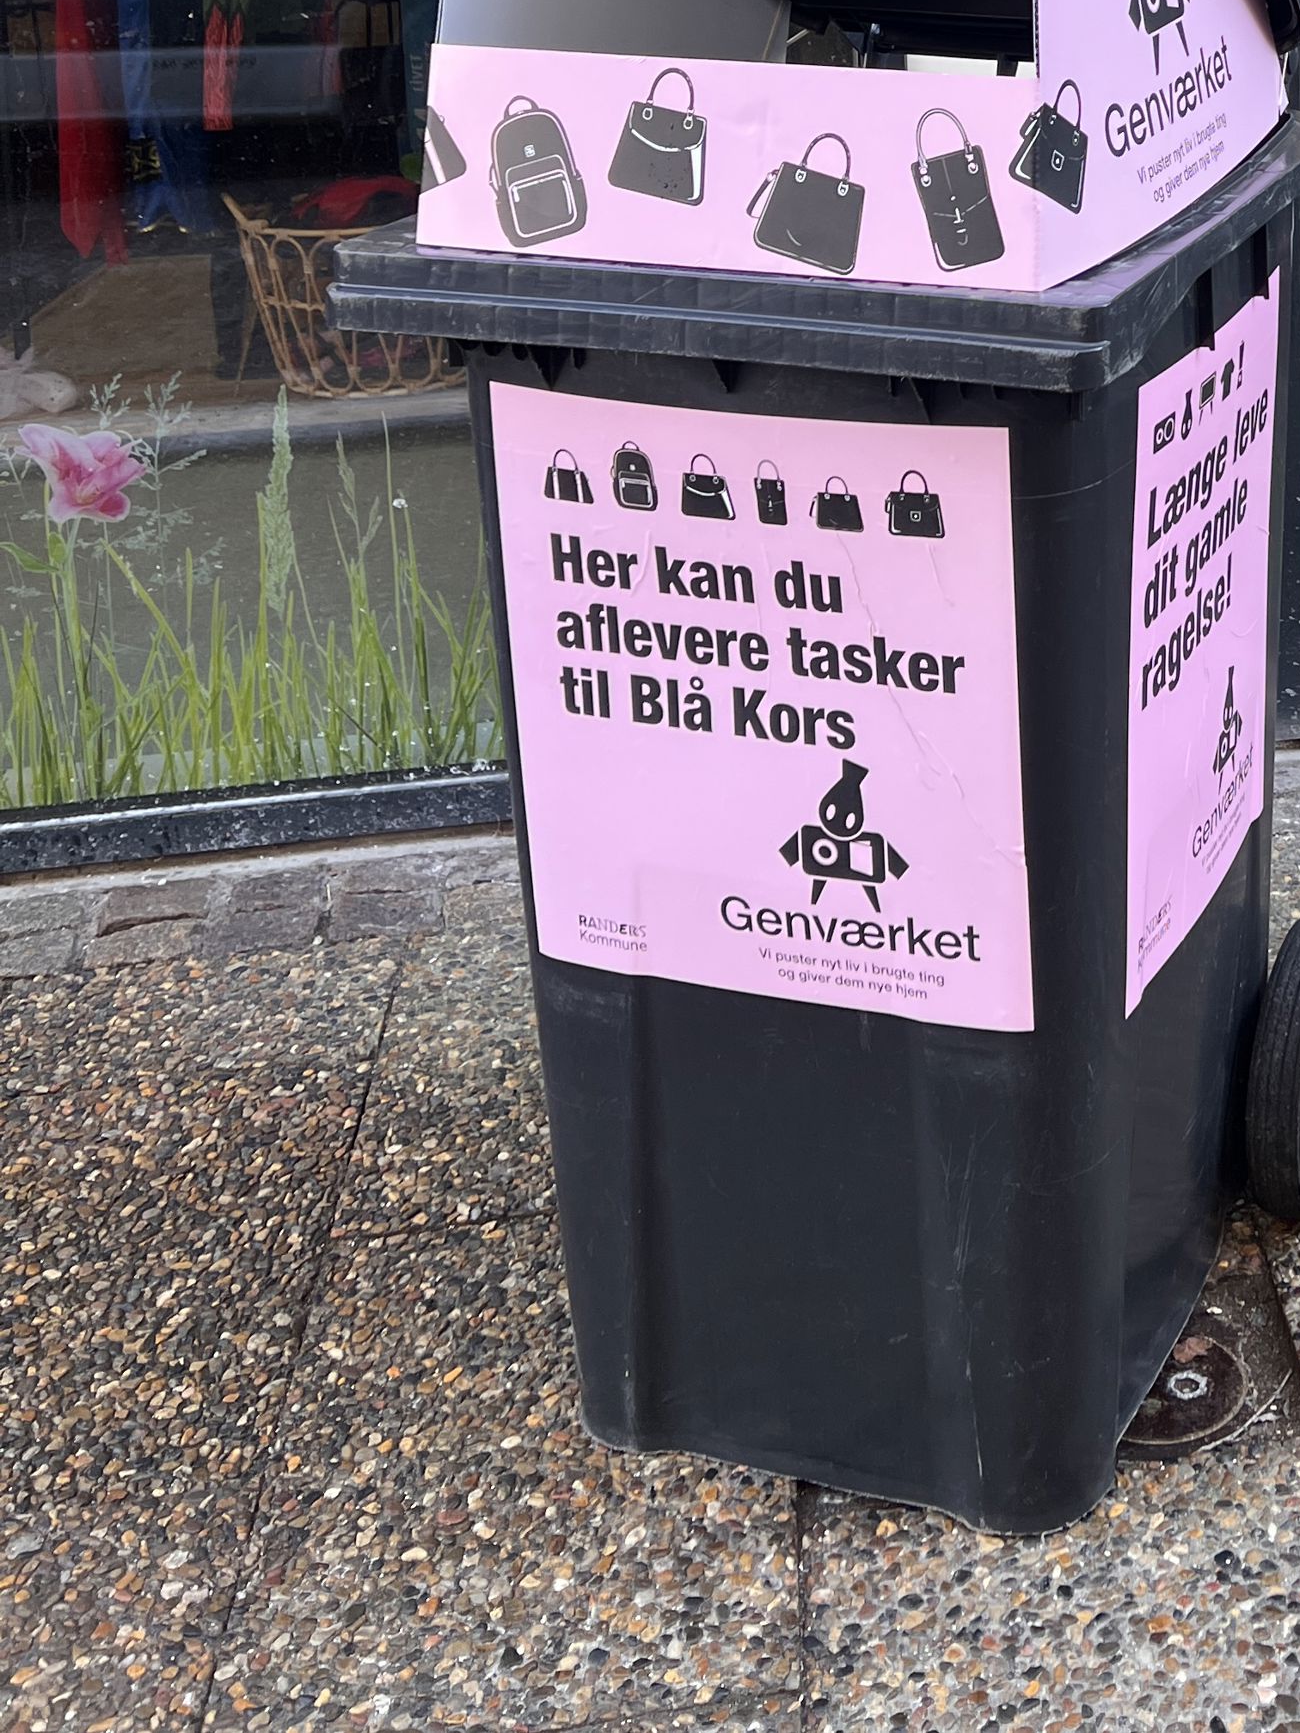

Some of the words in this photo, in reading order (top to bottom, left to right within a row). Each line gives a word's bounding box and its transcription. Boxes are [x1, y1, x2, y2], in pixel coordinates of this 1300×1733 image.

[1104, 34, 1232, 158] Genværket
[1136, 166, 1147, 184] Vi
[1147, 153, 1172, 183] puster
[1172, 142, 1186, 164] nyt
[1153, 186, 1165, 203] og
[1165, 172, 1183, 198] giver
[1183, 160, 1199, 181] dem
[1146, 434, 1229, 551] Længe
[1232, 388, 1268, 466] leve
[550, 532, 638, 591] Her
[653, 545, 756, 605] kan
[773, 560, 844, 614] du
[1143, 542, 1179, 630] dit
[1185, 477, 1248, 598] gamle
[555, 602, 770, 673] aflevere
[786, 626, 966, 695] tasker
[1141, 550, 1234, 712] ragelse!
[559, 665, 612, 720] til
[629, 673, 714, 735] Blå
[732, 685, 857, 751] Kors
[1192, 742, 1254, 858] Genværket
[578, 914, 647, 938] RANDERS
[579, 928, 648, 952] Kommune
[719, 894, 982, 963] Genværket
[758, 946, 771, 960] Vi
[775, 950, 818, 967] puster
[821, 957, 842, 971] nyt
[845, 958, 860, 973] liv
[871, 963, 915, 982] brugte
[919, 970, 945, 988] ting
[778, 968, 795, 981] og
[798, 970, 832, 985] giver
[834, 974, 865, 990] dem
[868, 980, 893, 994] nye
[895, 982, 928, 1000] hjem
